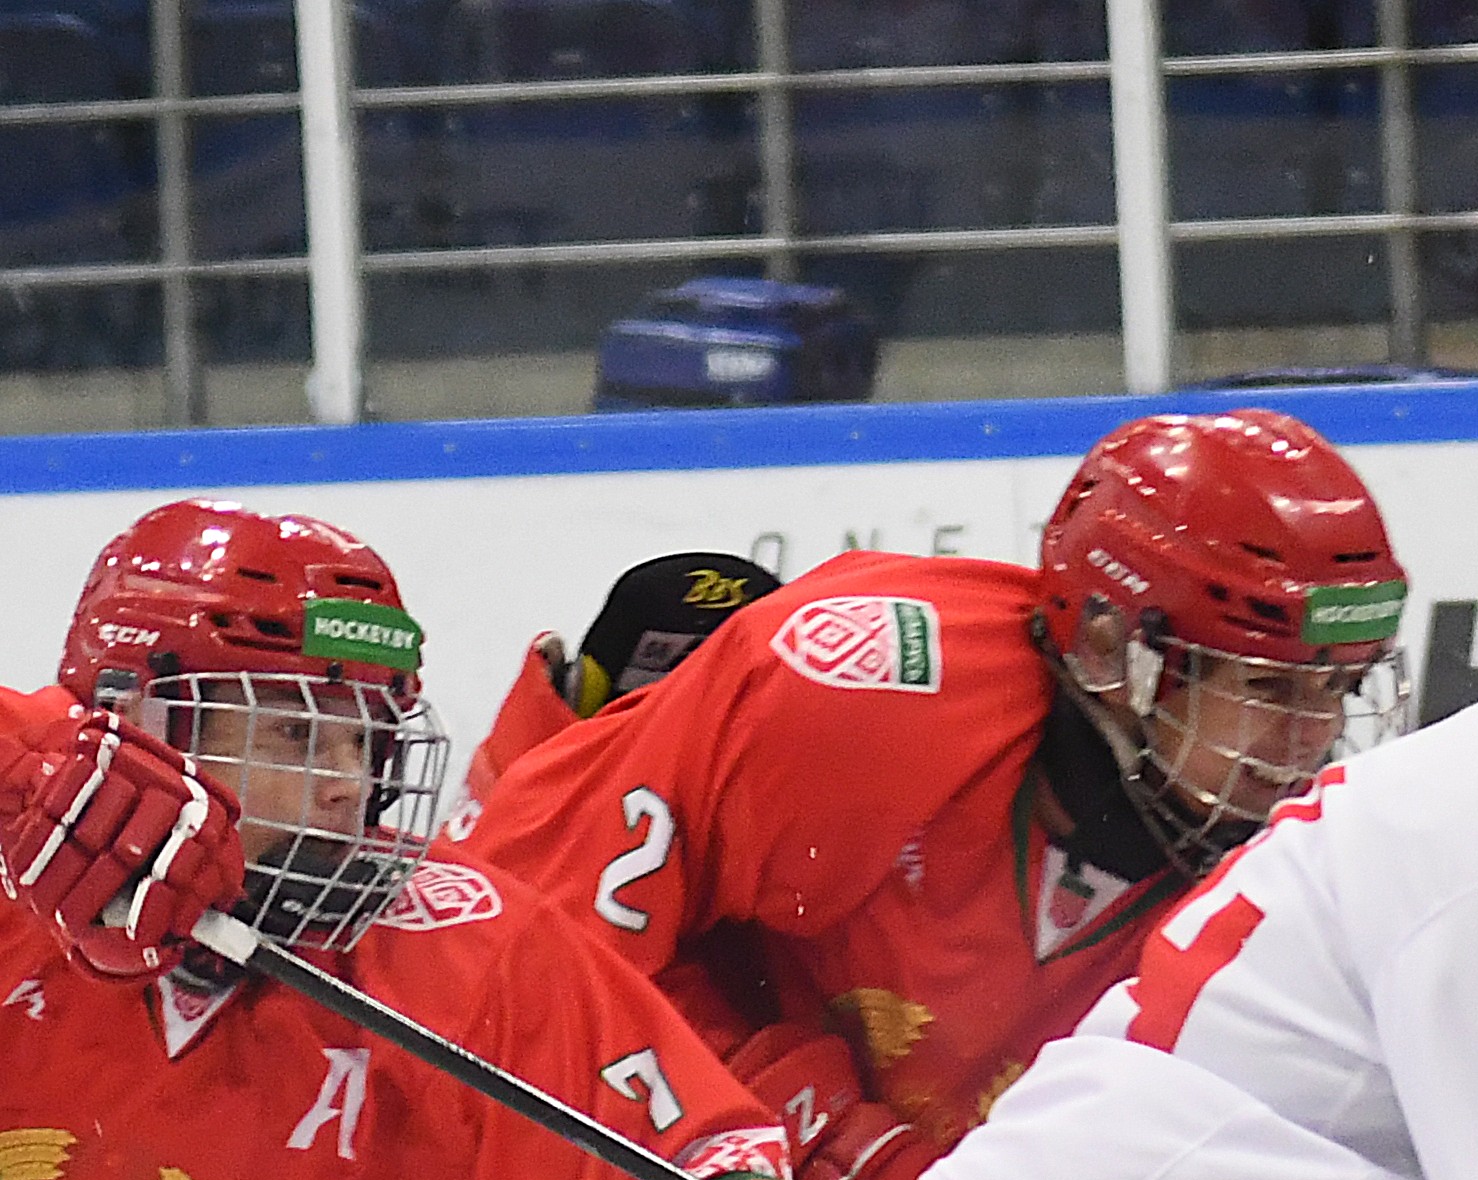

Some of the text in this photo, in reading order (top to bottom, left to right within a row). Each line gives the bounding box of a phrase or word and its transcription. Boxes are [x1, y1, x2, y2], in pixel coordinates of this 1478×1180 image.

[97, 622, 161, 647] CCM
[594, 784, 675, 934] 2
[285, 1047, 371, 1161] A
[600, 1045, 684, 1133] 7
